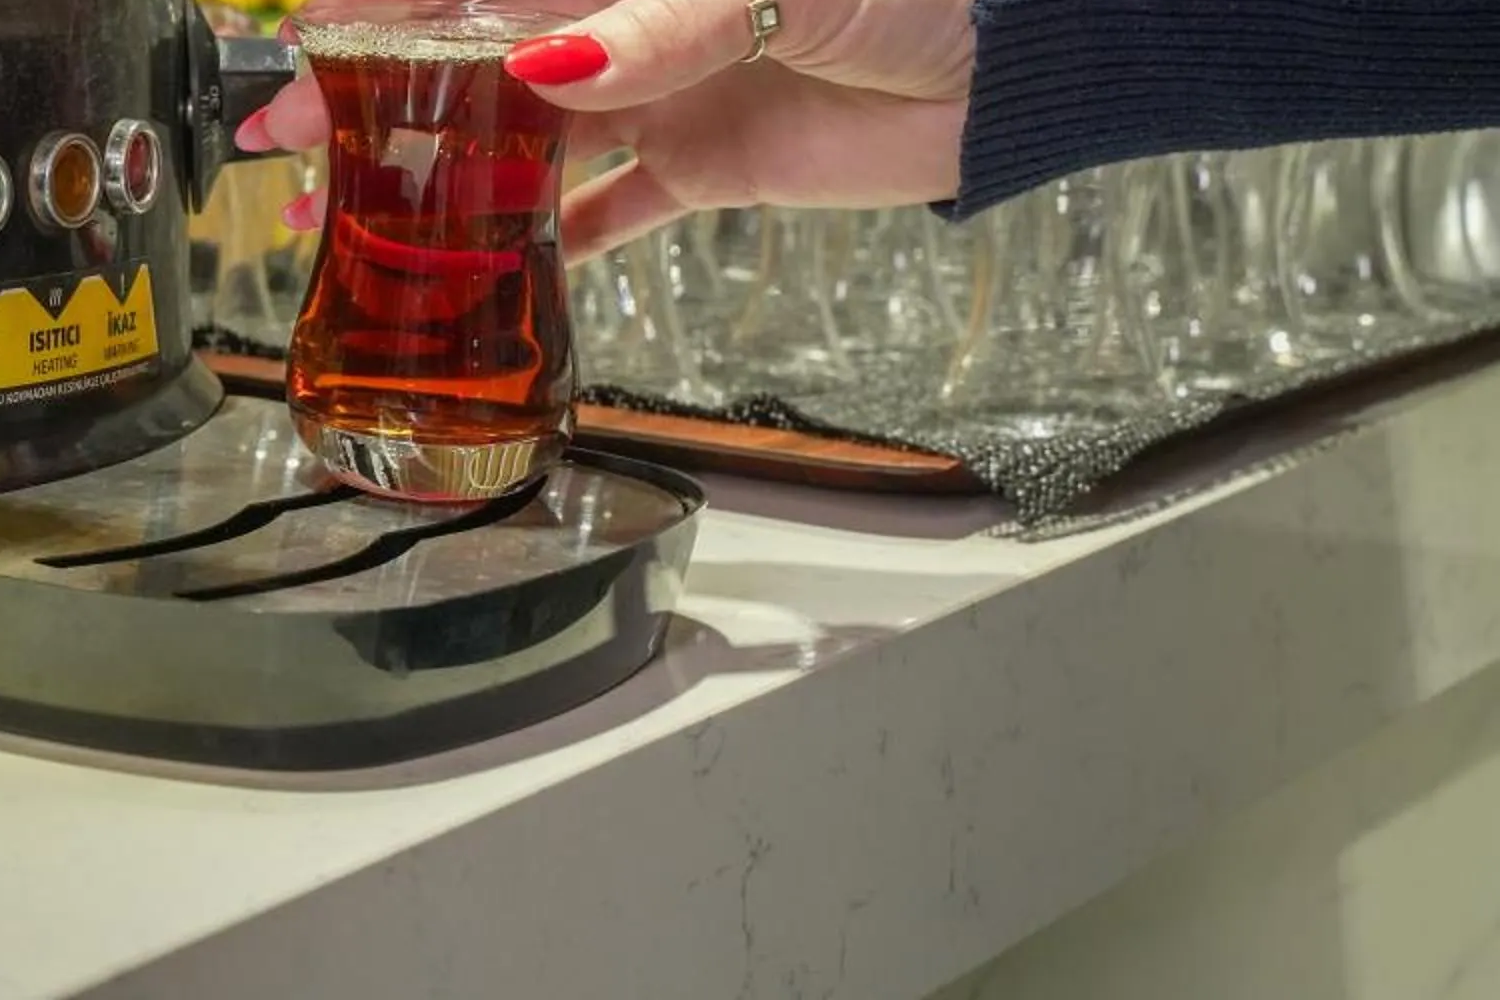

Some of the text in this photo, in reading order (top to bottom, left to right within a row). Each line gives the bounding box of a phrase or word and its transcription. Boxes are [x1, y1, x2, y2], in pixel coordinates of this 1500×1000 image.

[107, 311, 137, 338] İKAZ
[29, 324, 81, 353] ISITICI
[33, 354, 78, 376] HEATING
